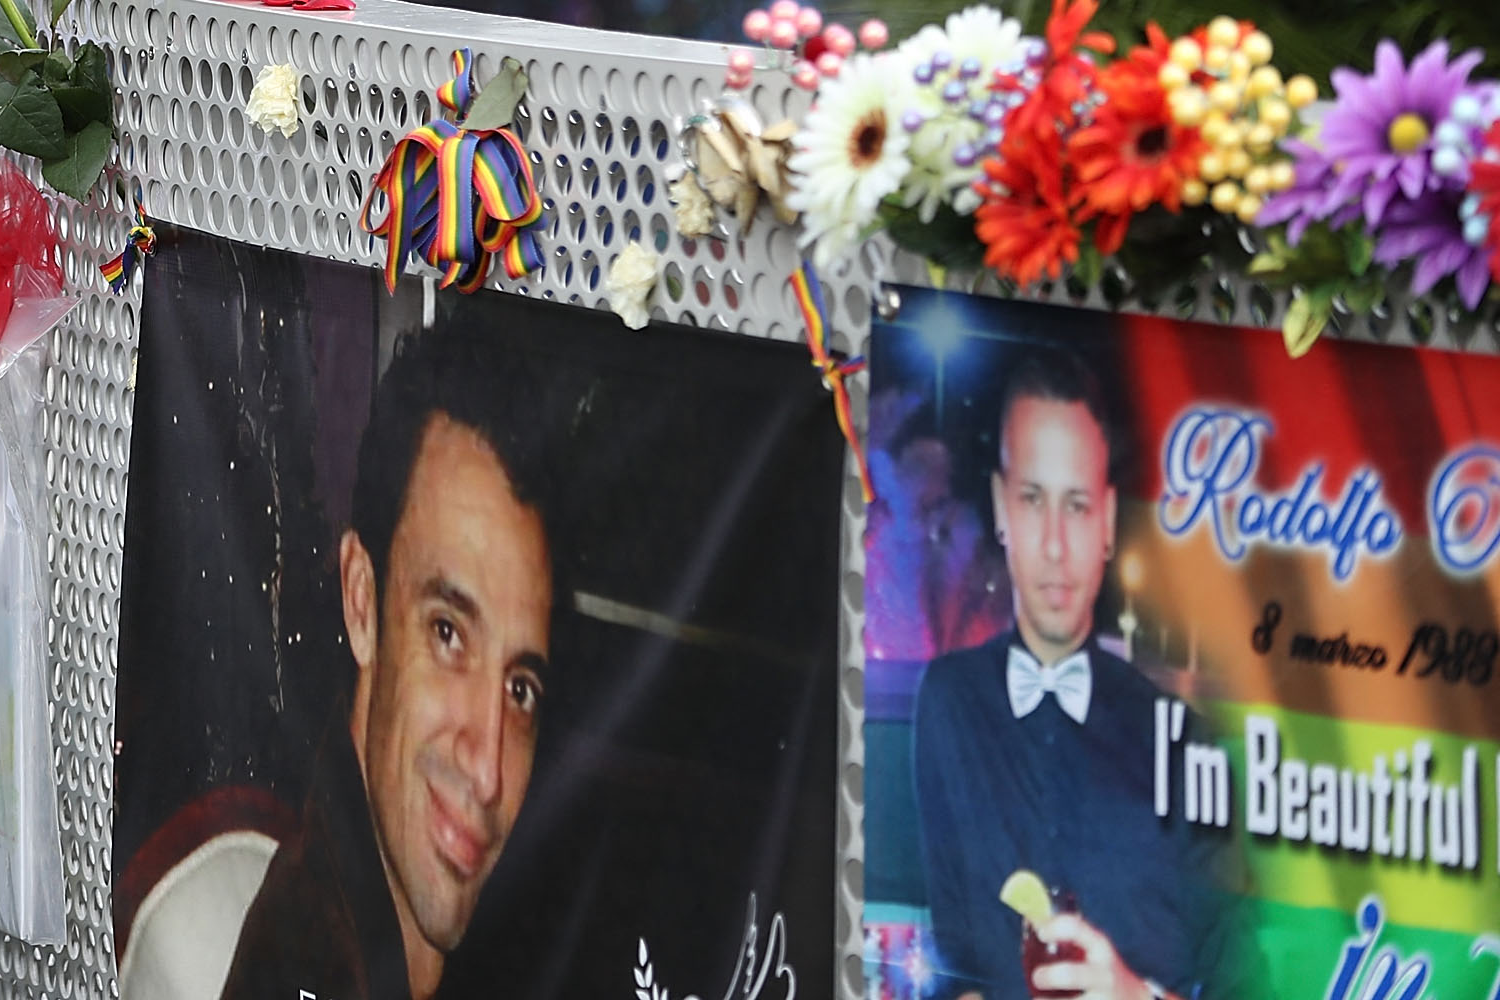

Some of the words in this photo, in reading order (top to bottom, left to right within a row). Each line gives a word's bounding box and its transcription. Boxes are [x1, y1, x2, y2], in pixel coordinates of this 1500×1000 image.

[1158, 402, 1404, 583] Rodolfo
[1290, 631, 1389, 670] marzo
[1153, 697, 1230, 829] I'm
[1244, 714, 1479, 871] Beautiful
